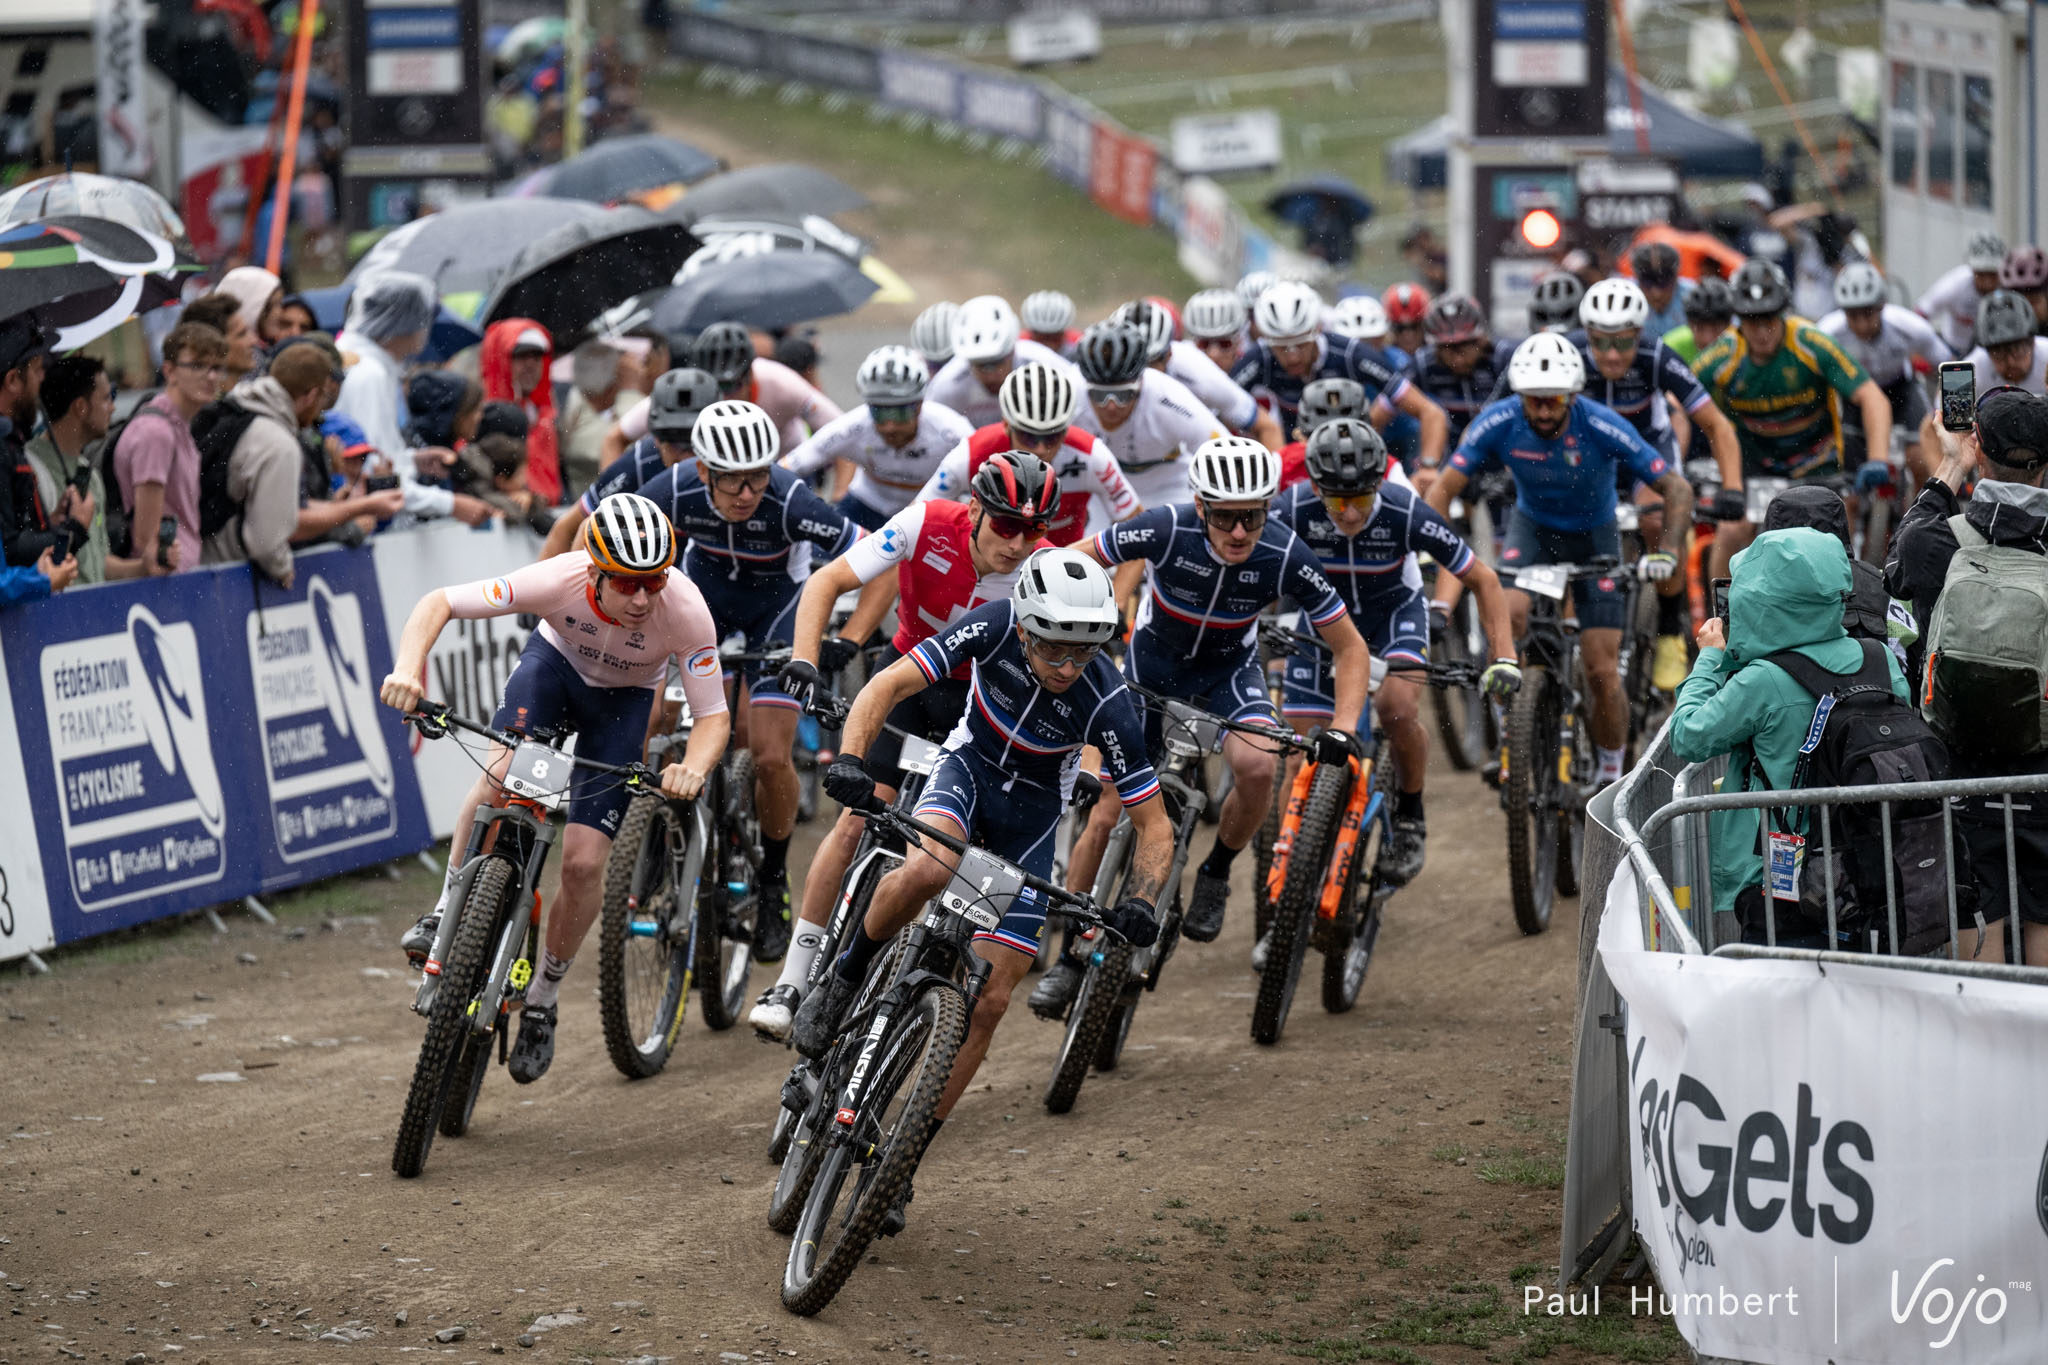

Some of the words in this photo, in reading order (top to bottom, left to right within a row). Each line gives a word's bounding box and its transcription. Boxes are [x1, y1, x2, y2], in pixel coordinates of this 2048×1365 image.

[798, 518, 841, 538] SKF
[1118, 529, 1155, 544] SKF
[1420, 520, 1459, 545] SKF
[1297, 564, 1331, 593] SKF
[944, 621, 988, 651] SKF
[54, 658, 129, 700] FÉDÉRATION
[59, 700, 135, 745] FRANÇAISE
[1812, 714, 1825, 742] DELTA
[1101, 730, 1127, 774] SKF
[531, 759, 550, 779] 8
[78, 760, 145, 808] CYCLISME
[977, 875, 994, 899] 1
[807, 953, 822, 982] SWISS
[1668, 1072, 1875, 1245] Gets
